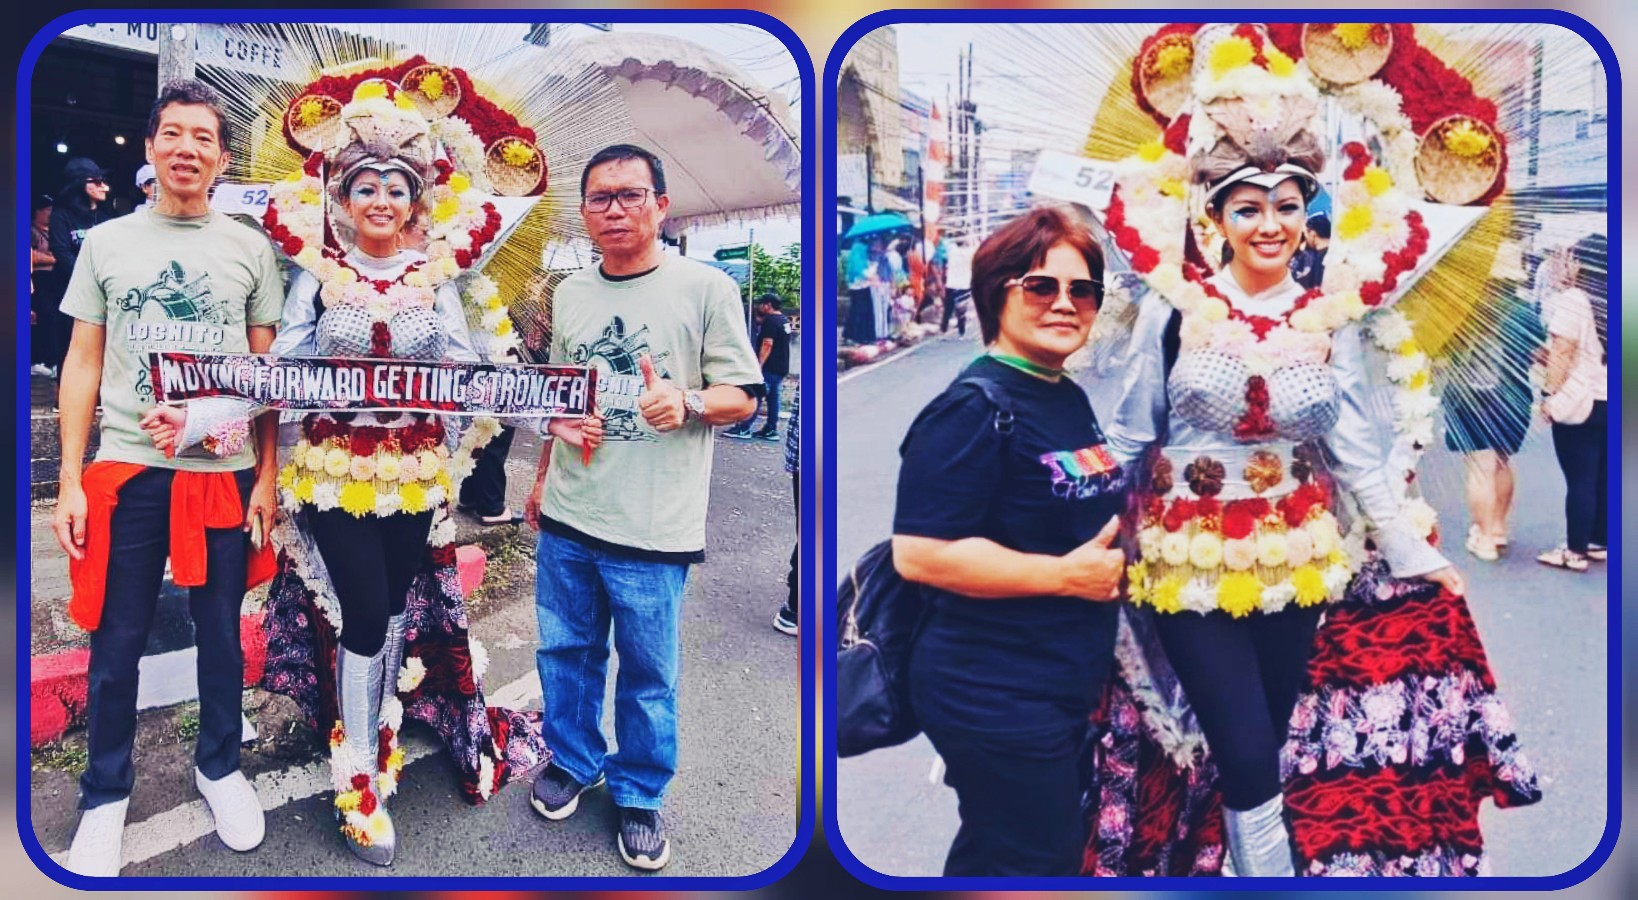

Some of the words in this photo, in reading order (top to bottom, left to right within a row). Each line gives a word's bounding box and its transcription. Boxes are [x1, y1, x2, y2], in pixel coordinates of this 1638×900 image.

[1075, 166, 1114, 190] 52
[241, 189, 268, 205] 52
[163, 360, 249, 397] MOVING
[254, 366, 365, 401] FORWARD
[373, 364, 468, 403] GETTING
[472, 370, 585, 410] STRONGER
